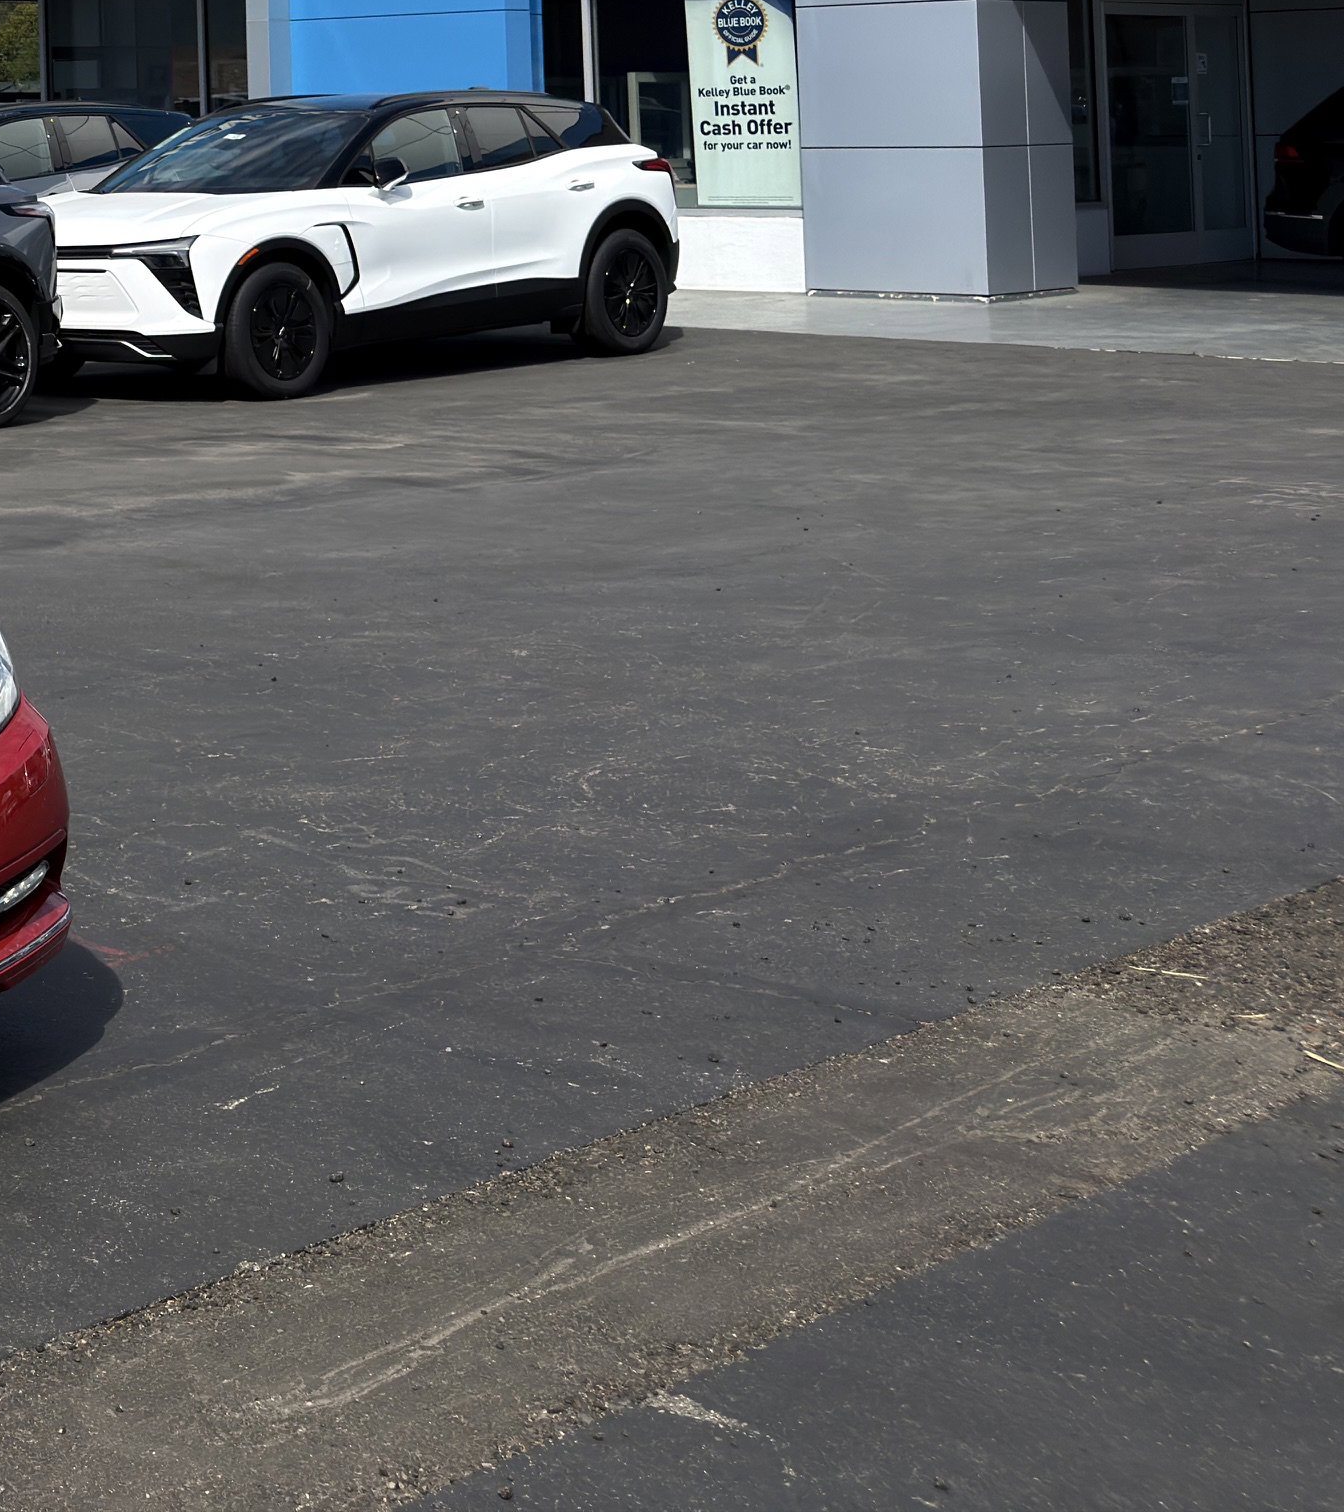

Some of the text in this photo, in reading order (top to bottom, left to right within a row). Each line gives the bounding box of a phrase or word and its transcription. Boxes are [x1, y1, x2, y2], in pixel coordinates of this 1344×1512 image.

[722, 0, 759, 15] KELLEY
[717, 16, 762, 28] BLUE BOOK
[730, 75, 756, 85] Get a
[698, 87, 730, 99] Kelley
[733, 86, 756, 96] Blue
[714, 99, 776, 117] Instant
[700, 118, 792, 136] Cash Offer
[703, 139, 792, 153] for your car now!
